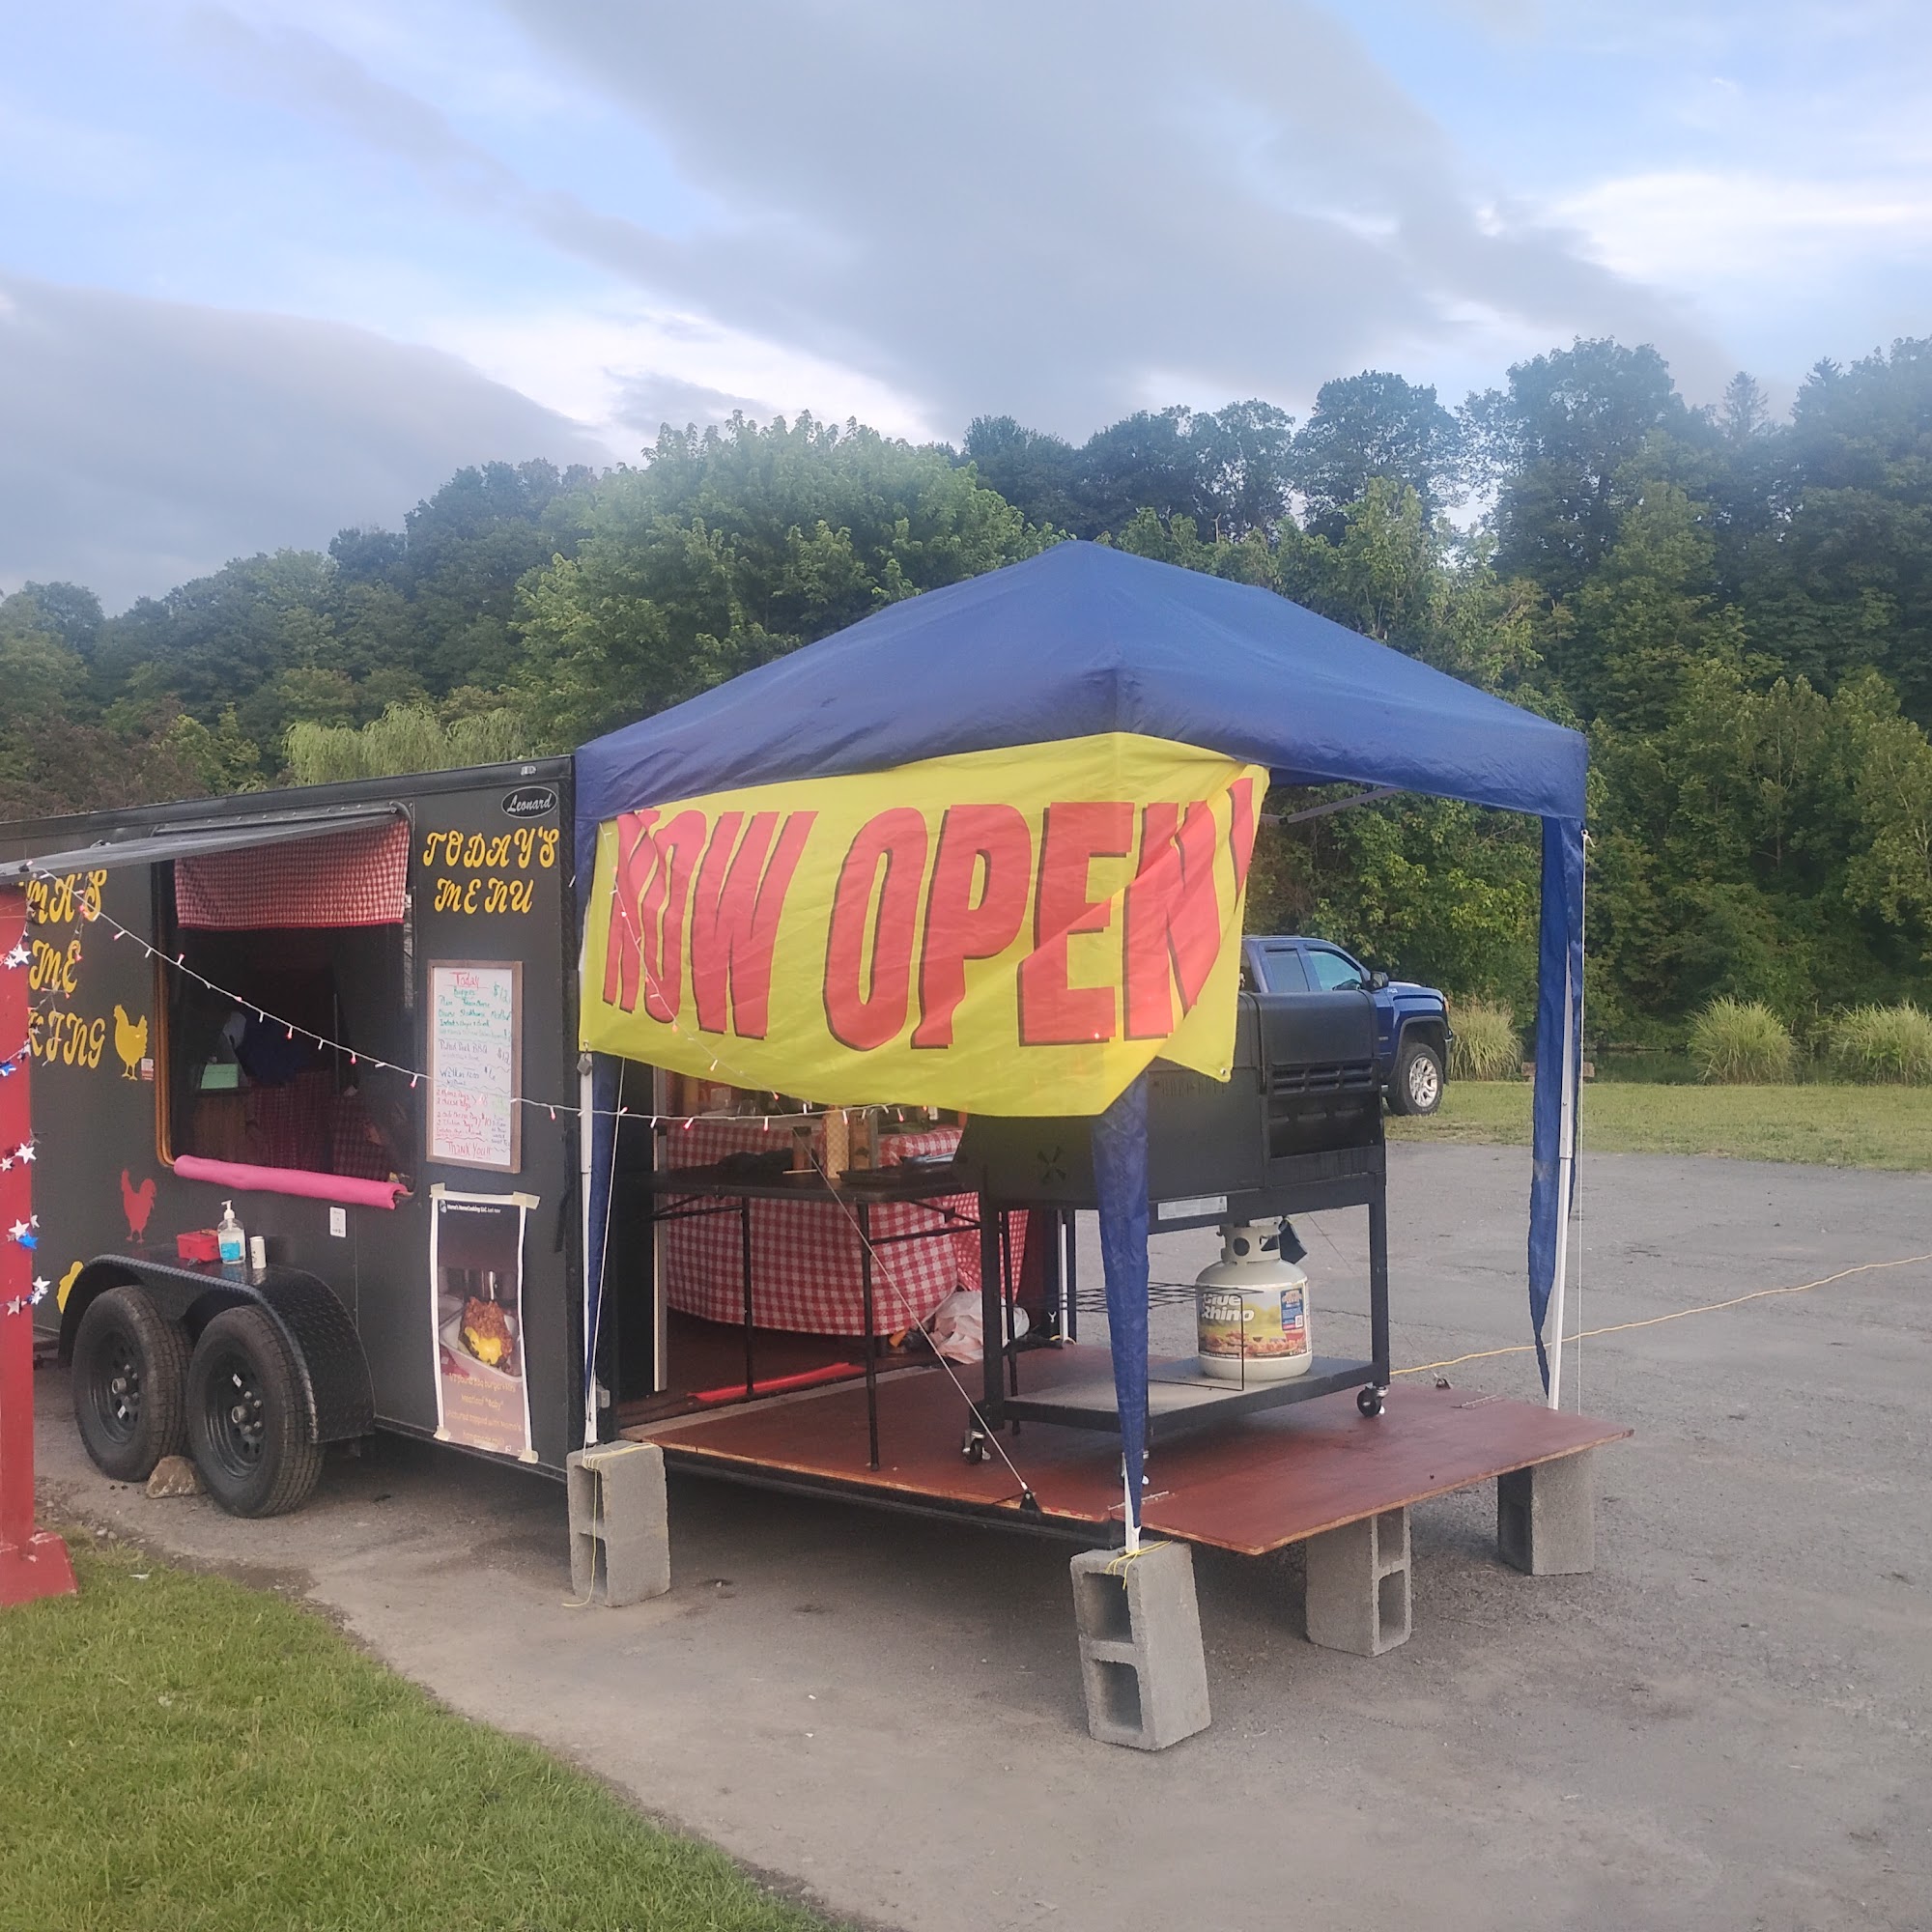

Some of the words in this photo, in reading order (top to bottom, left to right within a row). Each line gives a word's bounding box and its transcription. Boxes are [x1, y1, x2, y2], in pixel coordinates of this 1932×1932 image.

[506, 792, 554, 813] Leonard
[422, 826, 560, 868] TODAY'S
[434, 877, 534, 915] MENU
[603, 810, 819, 1040] NOW
[449, 972, 480, 990] Today
